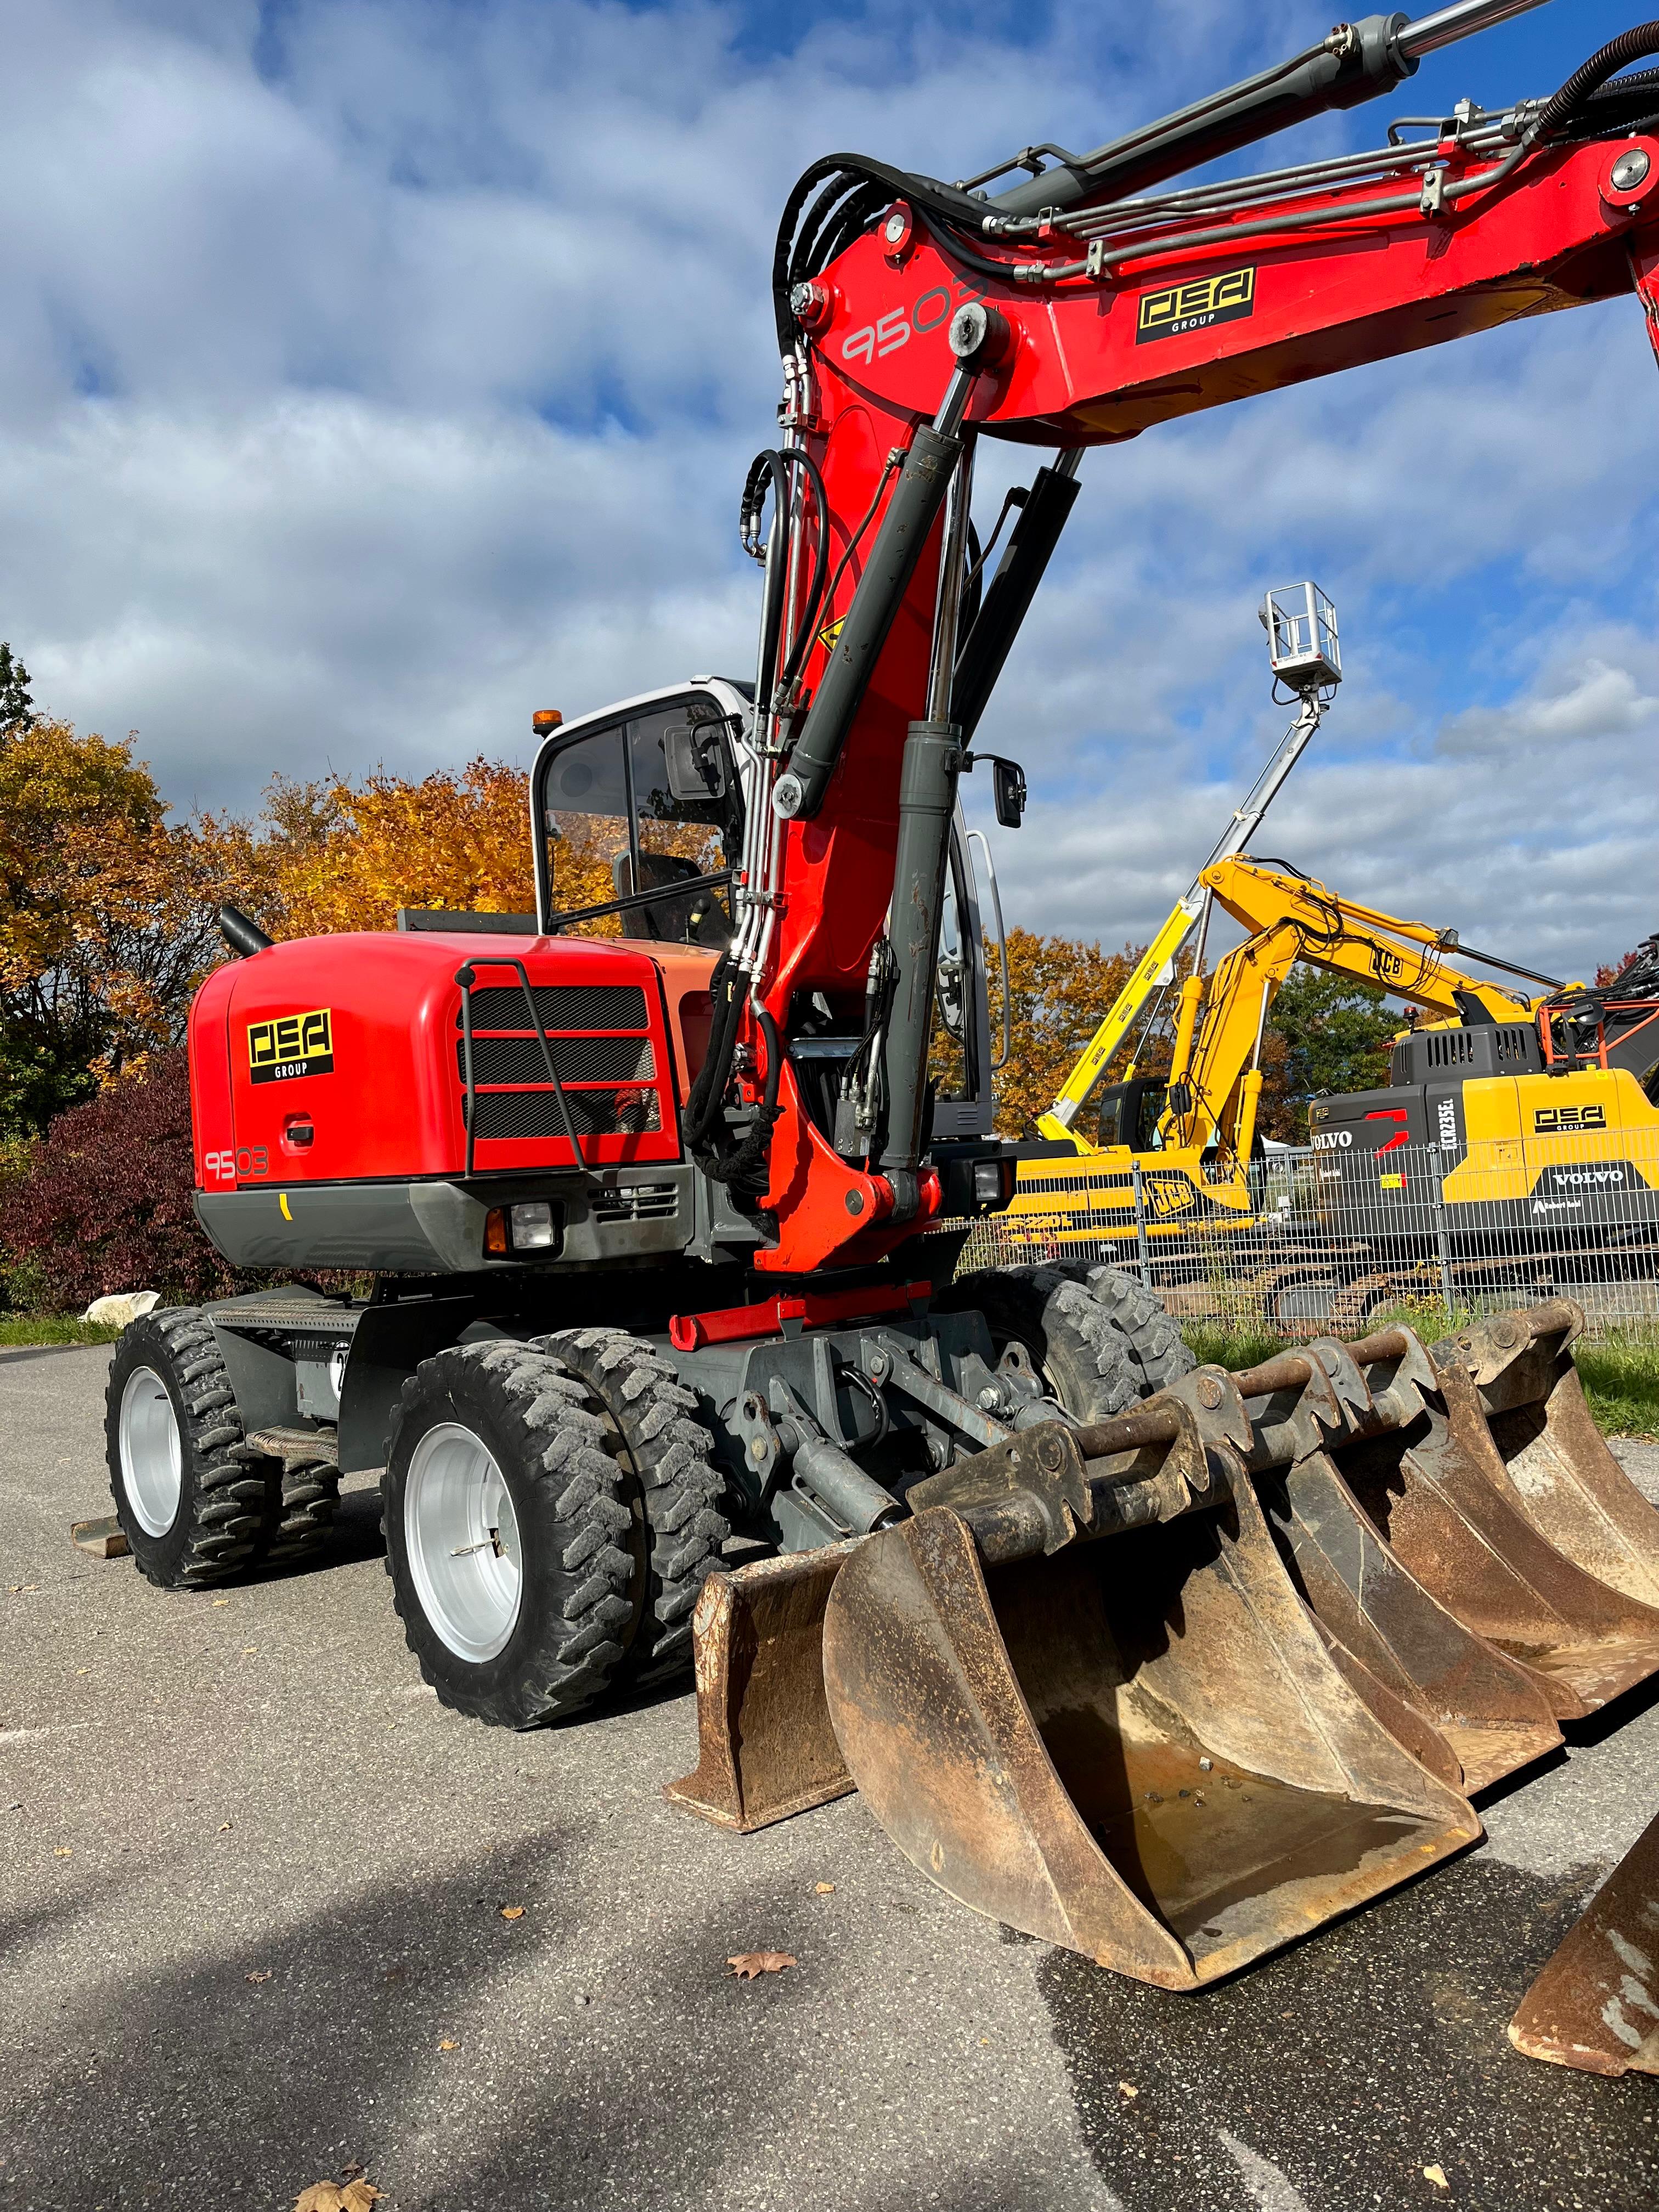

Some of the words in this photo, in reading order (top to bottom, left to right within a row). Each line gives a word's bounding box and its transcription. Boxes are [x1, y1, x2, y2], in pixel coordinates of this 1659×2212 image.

[842, 270, 989, 365] 9503
[1172, 313, 1215, 332] GROUP
[1372, 947, 1401, 975] JCB
[275, 1062, 307, 1078] GROUP
[1310, 1131, 1353, 1150] VOLVO
[205, 1146, 268, 1180] 9503
[1552, 1170, 1623, 1186] VOLVO
[1153, 1182, 1190, 1213] JCB
